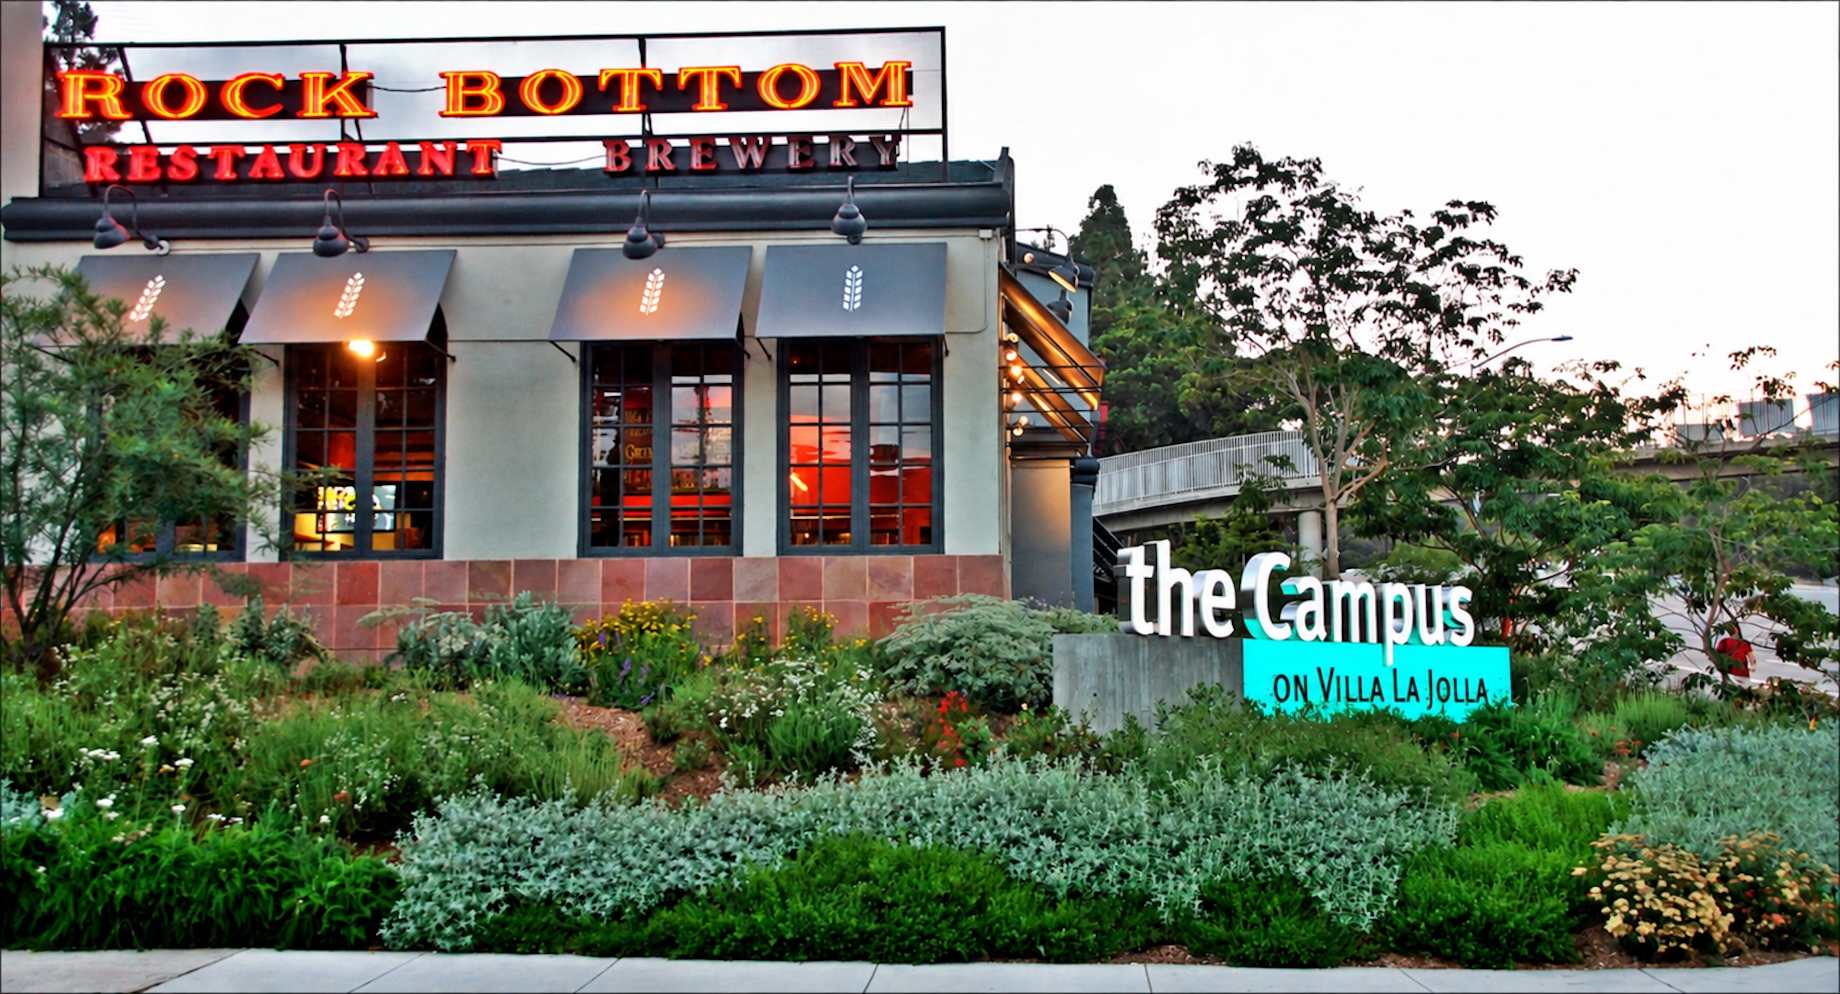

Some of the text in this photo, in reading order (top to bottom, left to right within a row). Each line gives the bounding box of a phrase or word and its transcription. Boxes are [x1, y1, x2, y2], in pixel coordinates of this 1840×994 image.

[56, 61, 913, 119] ROCK BOTTOM
[83, 135, 899, 182] RESTAURANT BREWERY
[1115, 539, 1475, 666] the Campus
